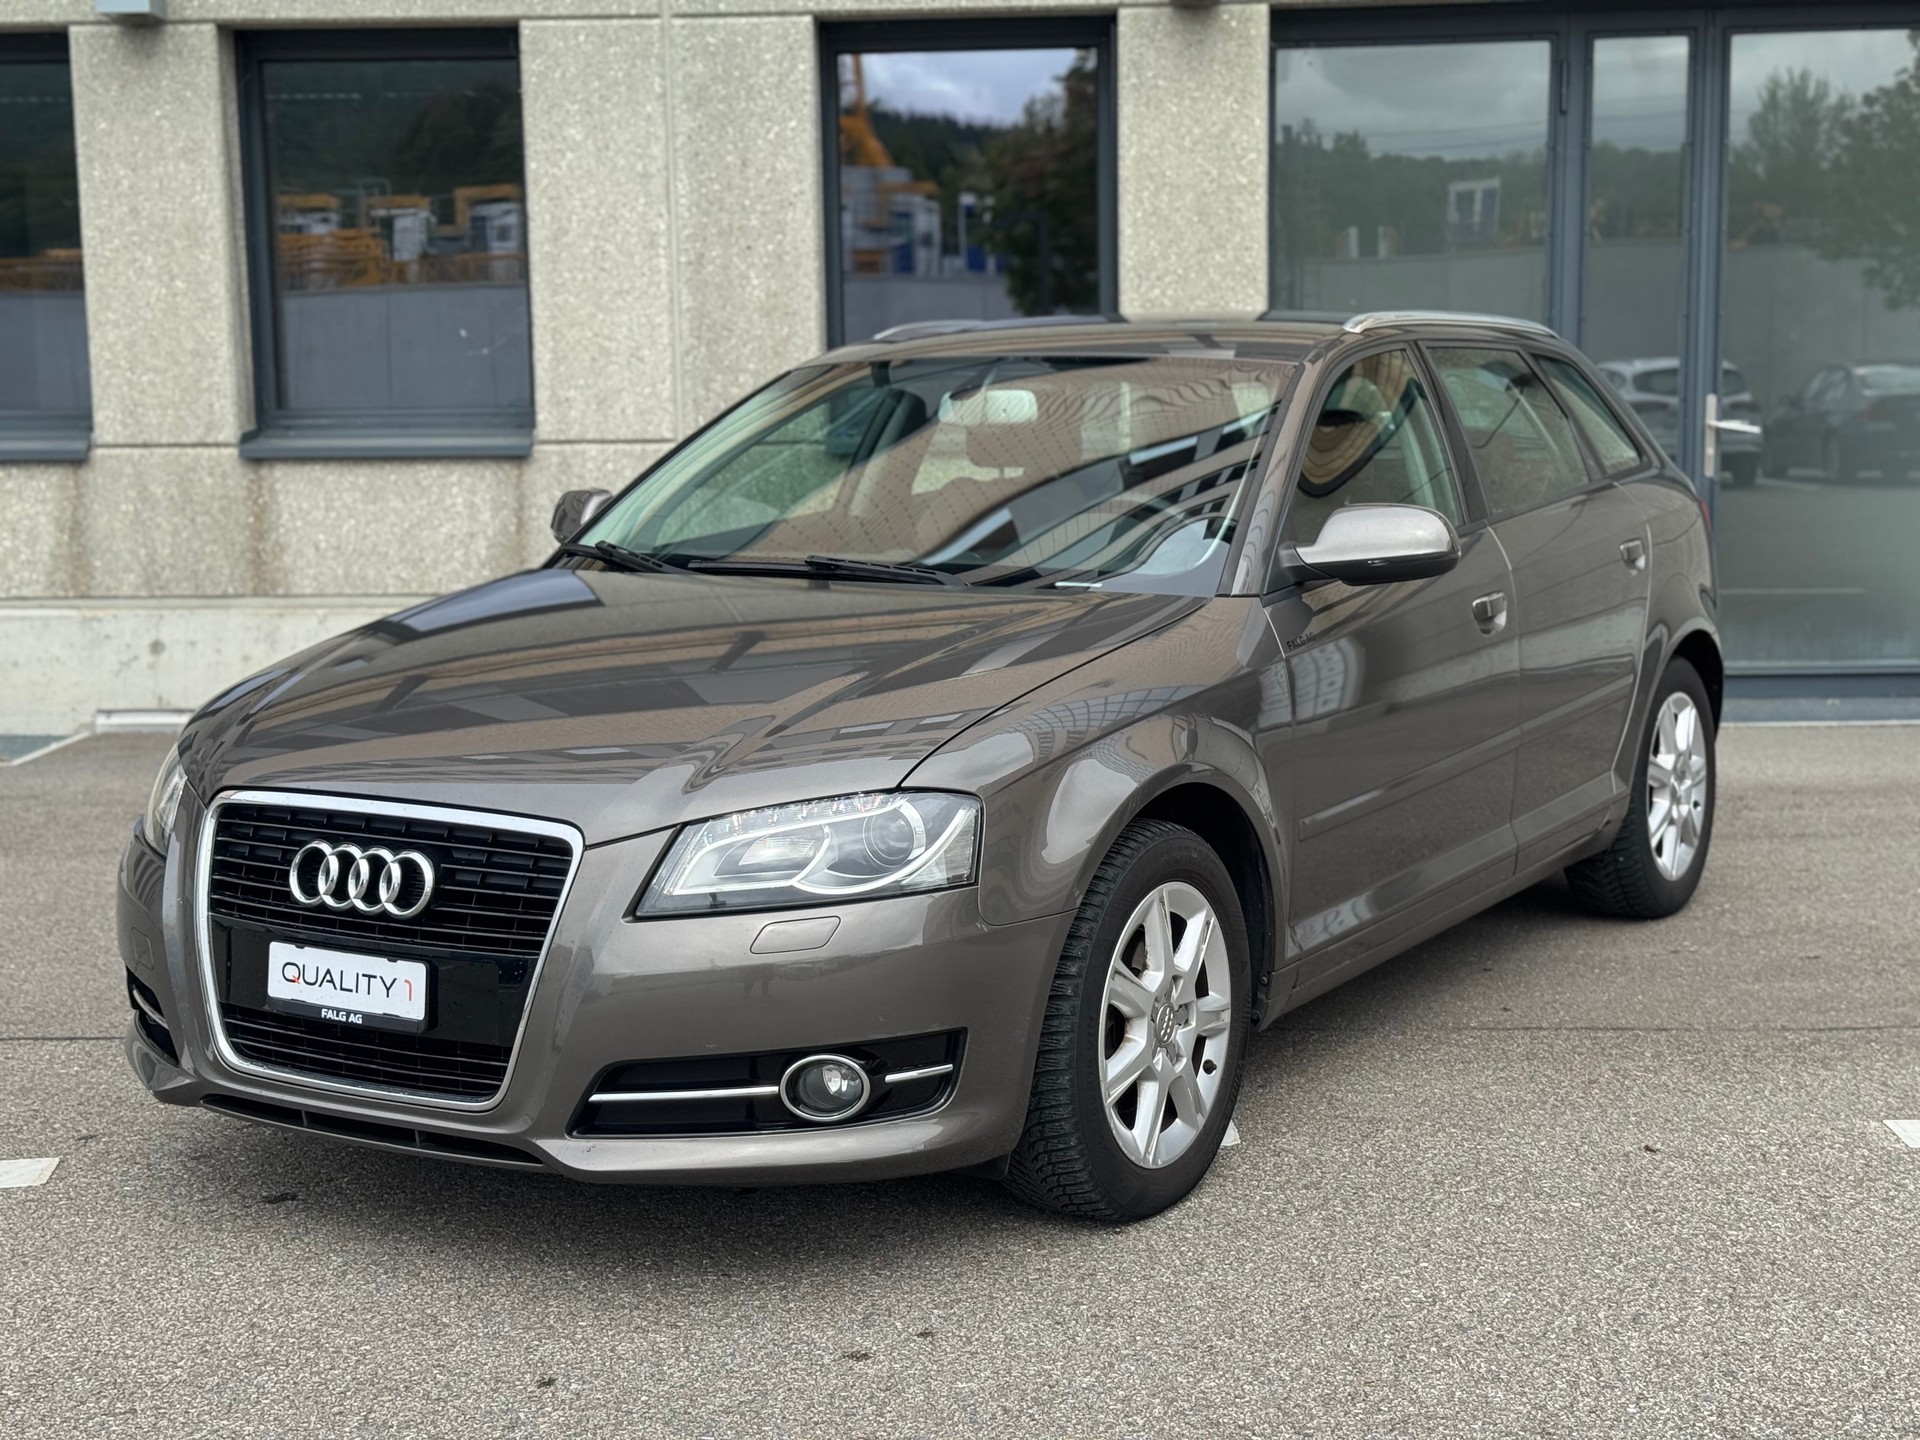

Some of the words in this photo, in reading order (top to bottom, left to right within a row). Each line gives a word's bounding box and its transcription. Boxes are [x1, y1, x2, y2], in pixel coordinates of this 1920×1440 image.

[1286, 635, 1307, 651] FALG
[282, 961, 398, 998] QUALITY
[321, 1008, 347, 1022] FALG
[348, 1012, 363, 1024] AG
